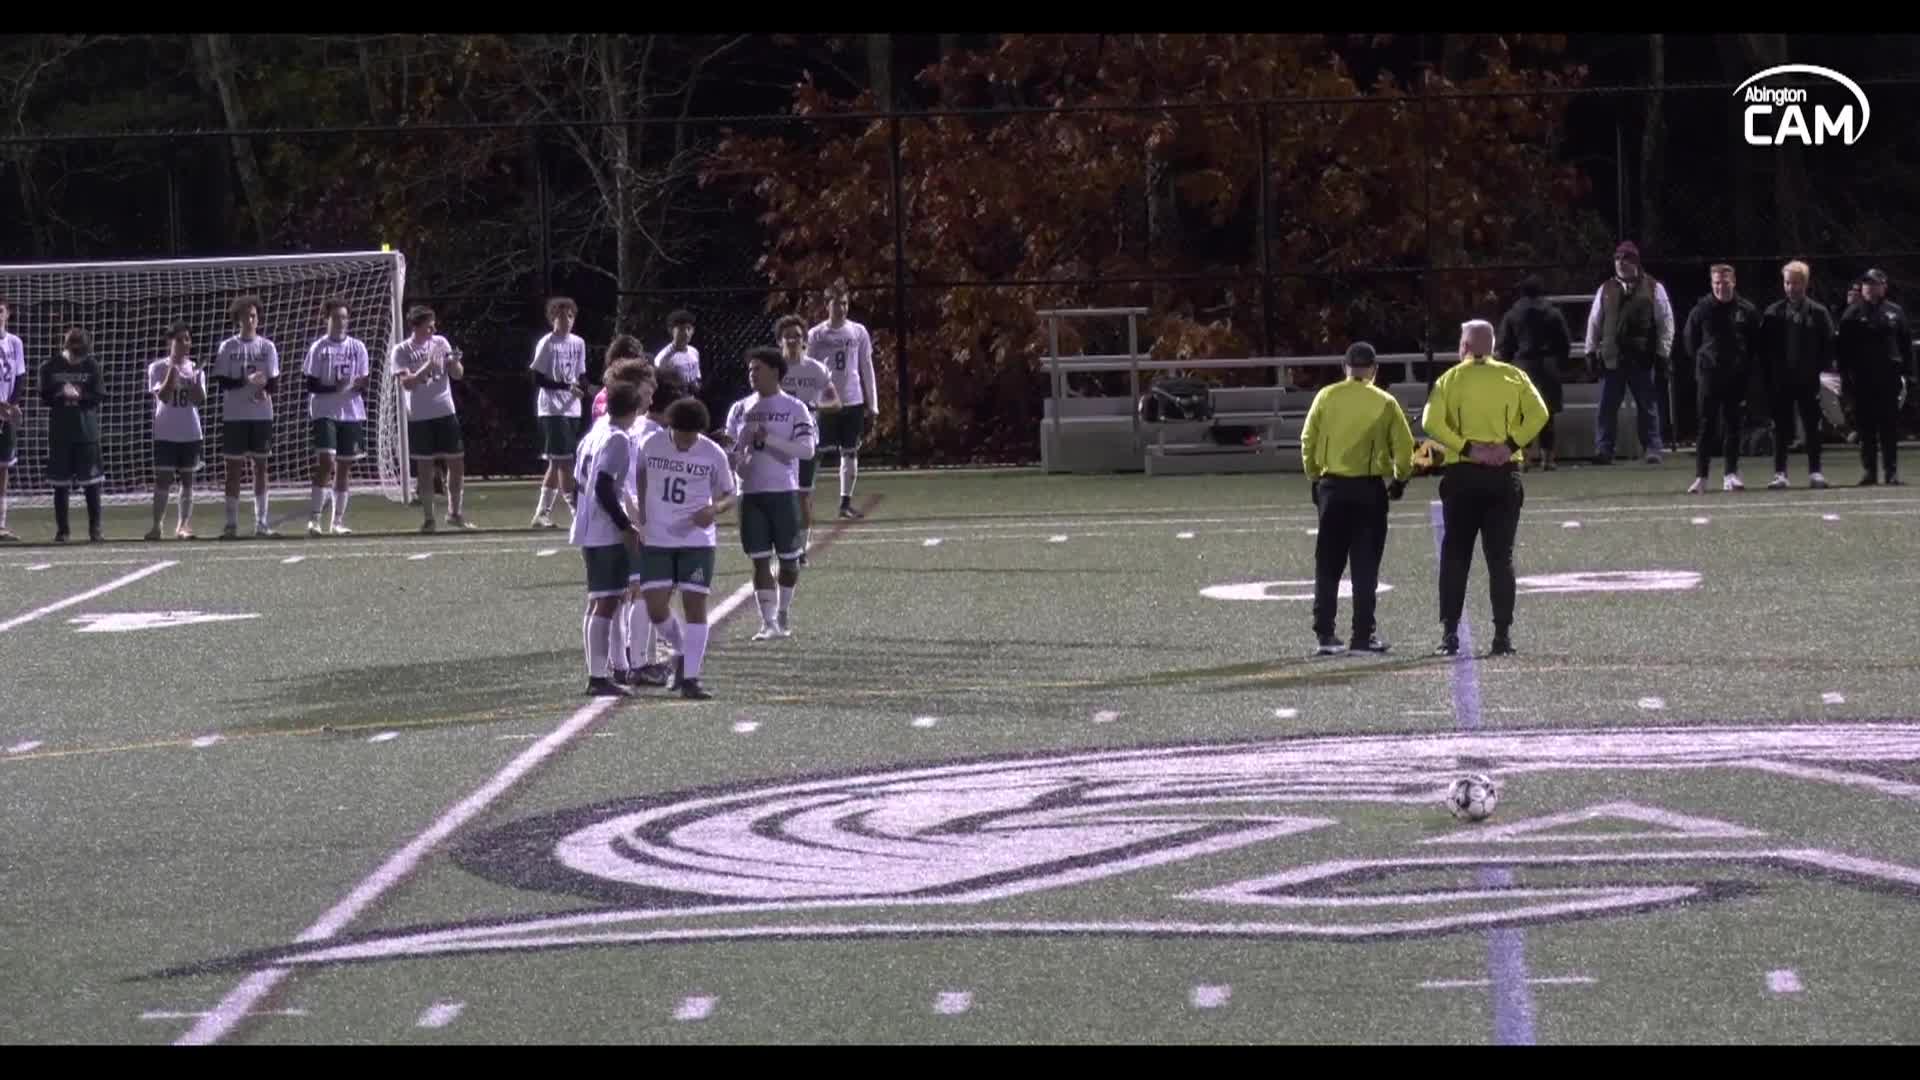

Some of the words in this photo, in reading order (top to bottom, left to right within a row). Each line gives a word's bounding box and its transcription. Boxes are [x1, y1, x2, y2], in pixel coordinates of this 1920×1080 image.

[835, 350, 846, 371] 8
[648, 456, 685, 472] STURGIS
[686, 463, 711, 476] WEST
[661, 476, 688, 504] 16
